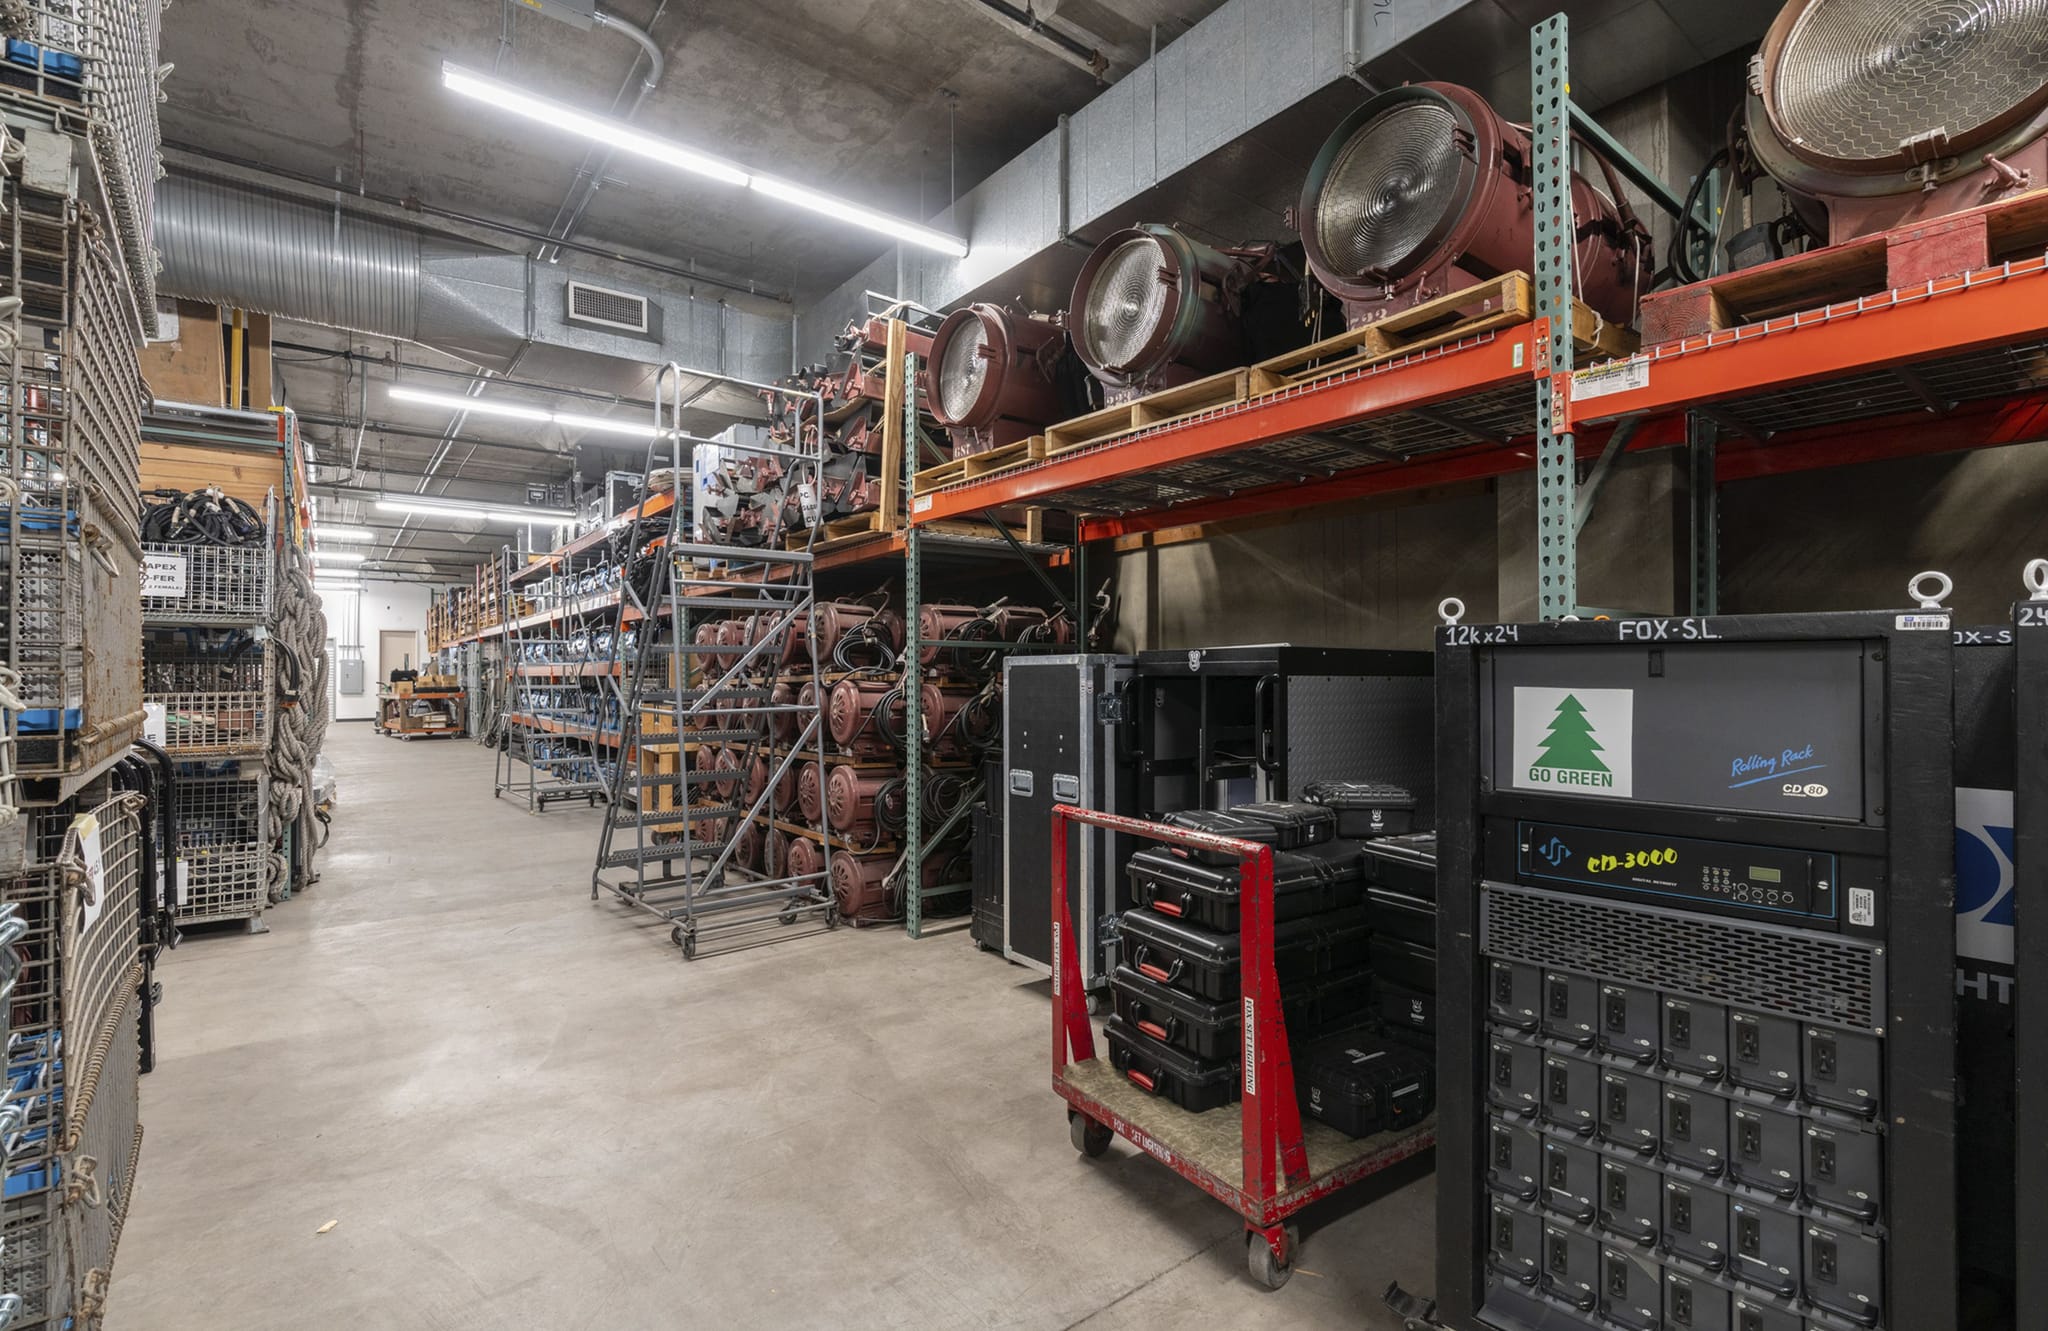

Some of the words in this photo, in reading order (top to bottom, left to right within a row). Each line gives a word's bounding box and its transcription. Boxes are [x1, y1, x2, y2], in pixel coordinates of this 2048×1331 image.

[147, 562, 177, 571] APEX
[1731, 754, 1777, 777] Rolling
[1781, 743, 1814, 768] Rack
[1529, 767, 1551, 782] GO
[1556, 769, 1613, 788] GREEN
[1782, 783, 1802, 794] CD
[1808, 785, 1823, 795] 80
[1956, 967, 2015, 1005] HT
[1245, 1000, 1253, 1018] FOX
[1246, 1042, 1254, 1093] LIGHTING
